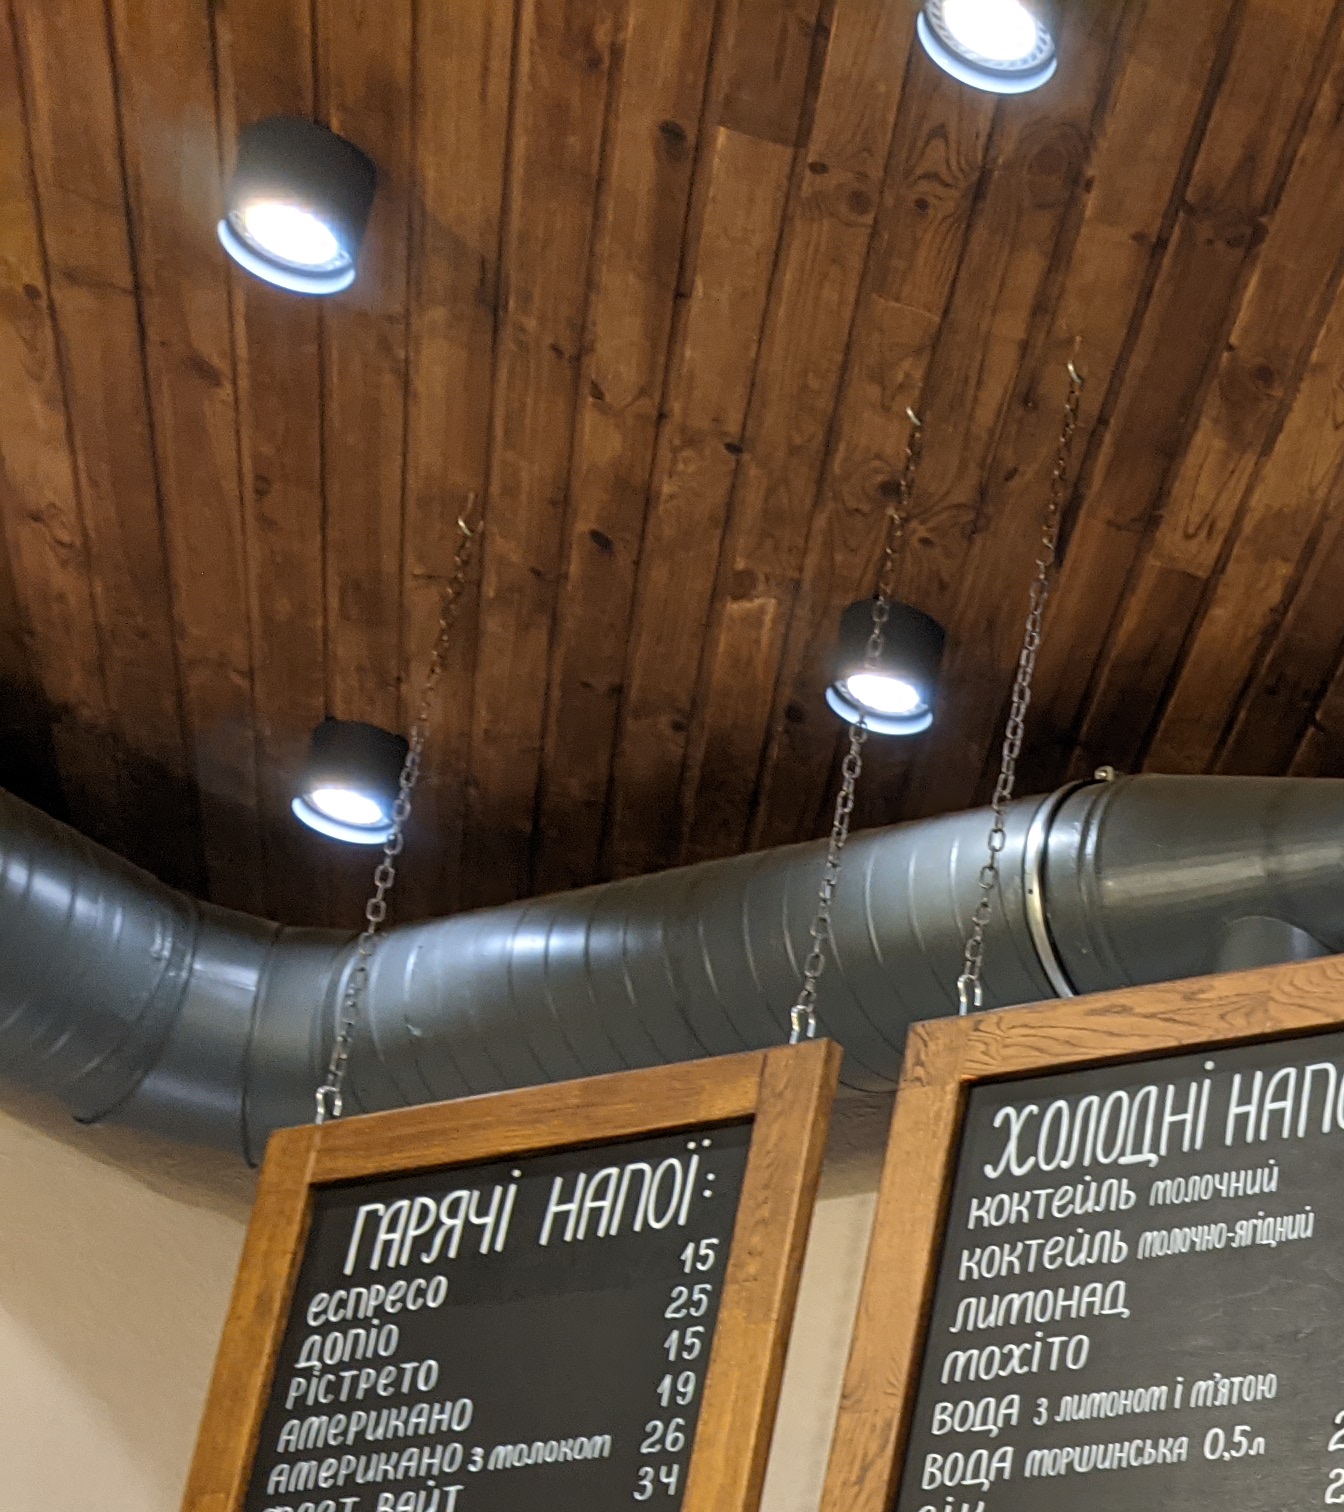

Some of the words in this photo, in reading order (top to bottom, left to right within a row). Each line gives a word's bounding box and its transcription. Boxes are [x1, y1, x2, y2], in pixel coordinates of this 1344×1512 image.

[983, 1059, 1216, 1180] ХОЛОДНІ
[343, 1169, 521, 1276] ГАРЯЧІ
[538, 1139, 715, 1246] НАПОЇ:
[295, 1318, 400, 1371] ДОПІО
[664, 1283, 712, 1319] 25
[949, 1279, 1131, 1333] ЛИМОНАД
[656, 1370, 696, 1407] 19
[931, 1393, 1021, 1438] ВОДА
[633, 1463, 680, 1501] 34
[920, 1444, 1013, 1492] ВОДА
